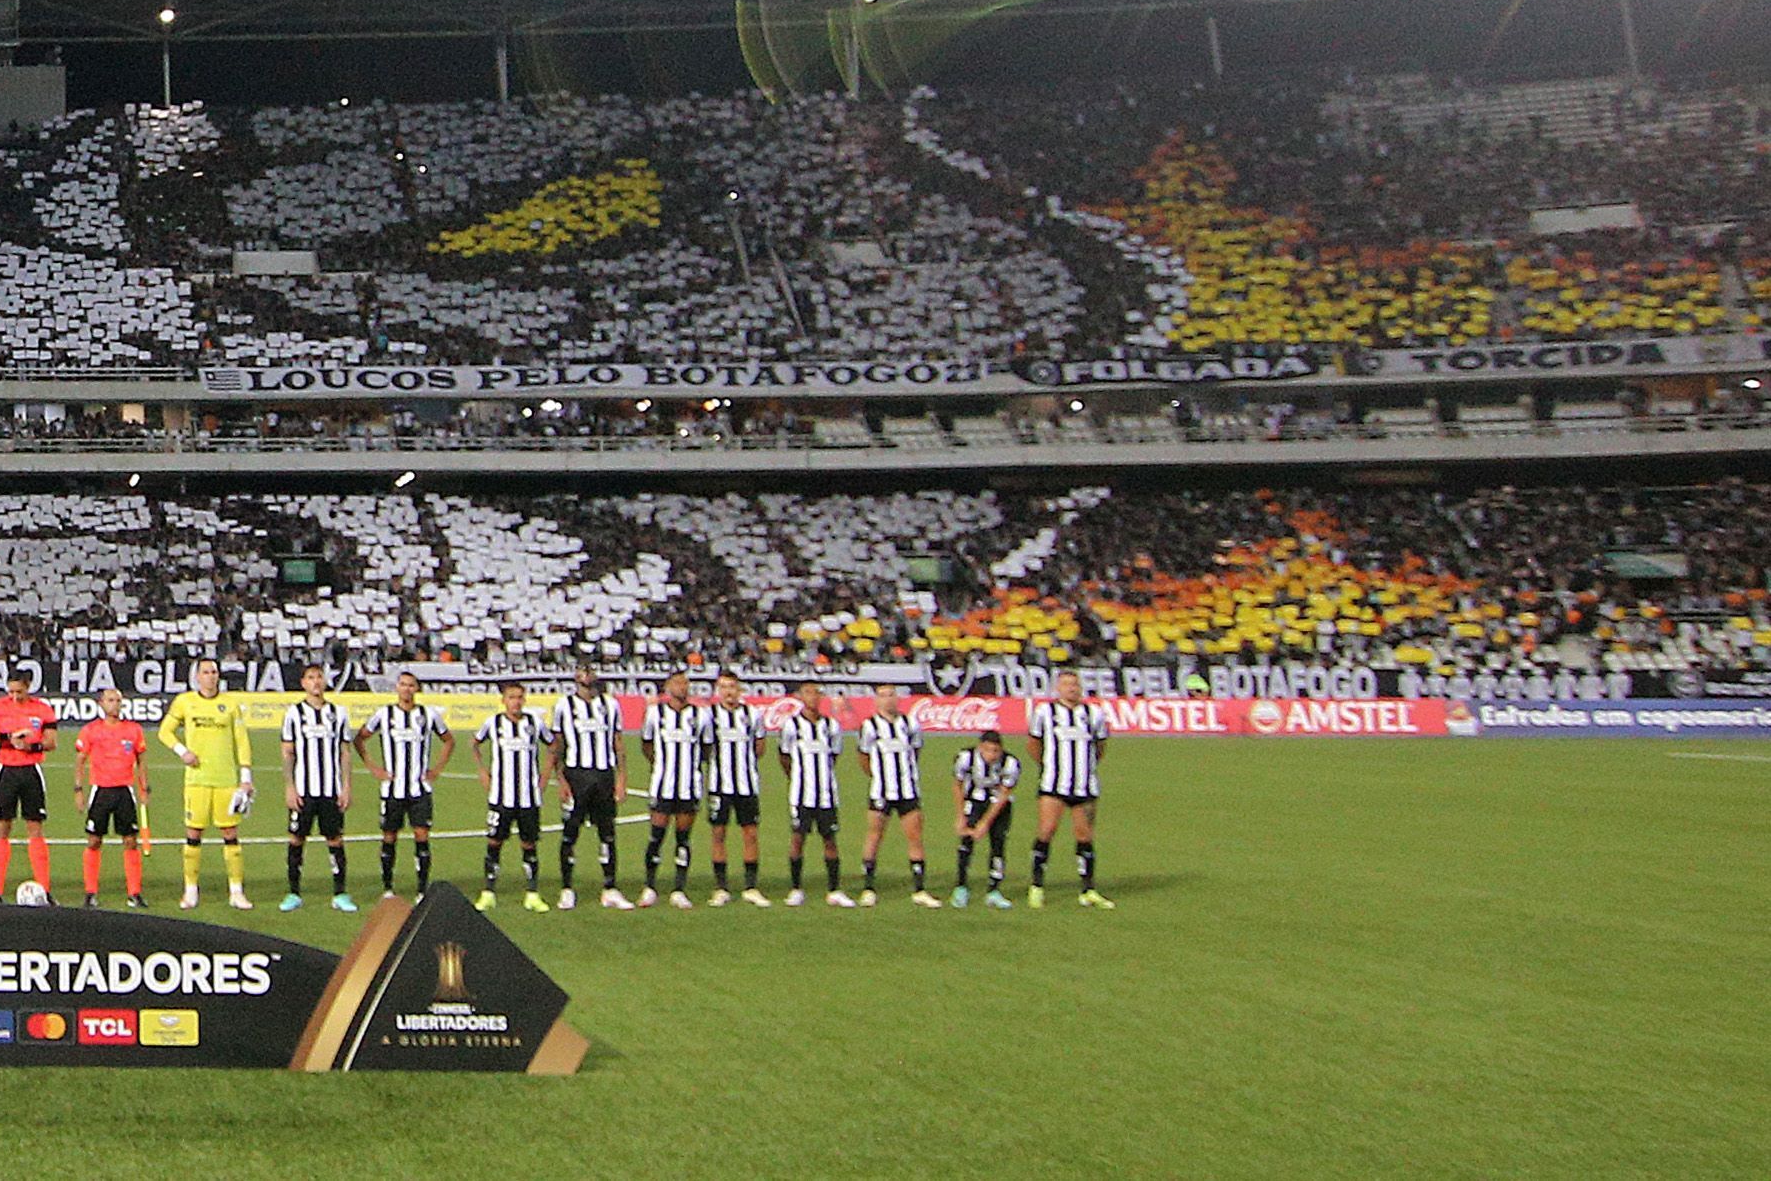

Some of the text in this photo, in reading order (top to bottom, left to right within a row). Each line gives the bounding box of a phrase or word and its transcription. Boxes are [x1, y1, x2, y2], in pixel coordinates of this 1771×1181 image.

[1062, 356, 1312, 384] FOLGADA
[1412, 342, 1666, 372] TORCIDA
[247, 369, 457, 391] LOUCOS
[477, 366, 622, 390] PELO
[1208, 665, 1378, 699] BOTAFOGO
[1100, 700, 1228, 733] AMSTEL
[1287, 700, 1422, 733] AMSTEL
[83, 1019, 132, 1037] TCL
[396, 1015, 508, 1031] LIBERTADORES
